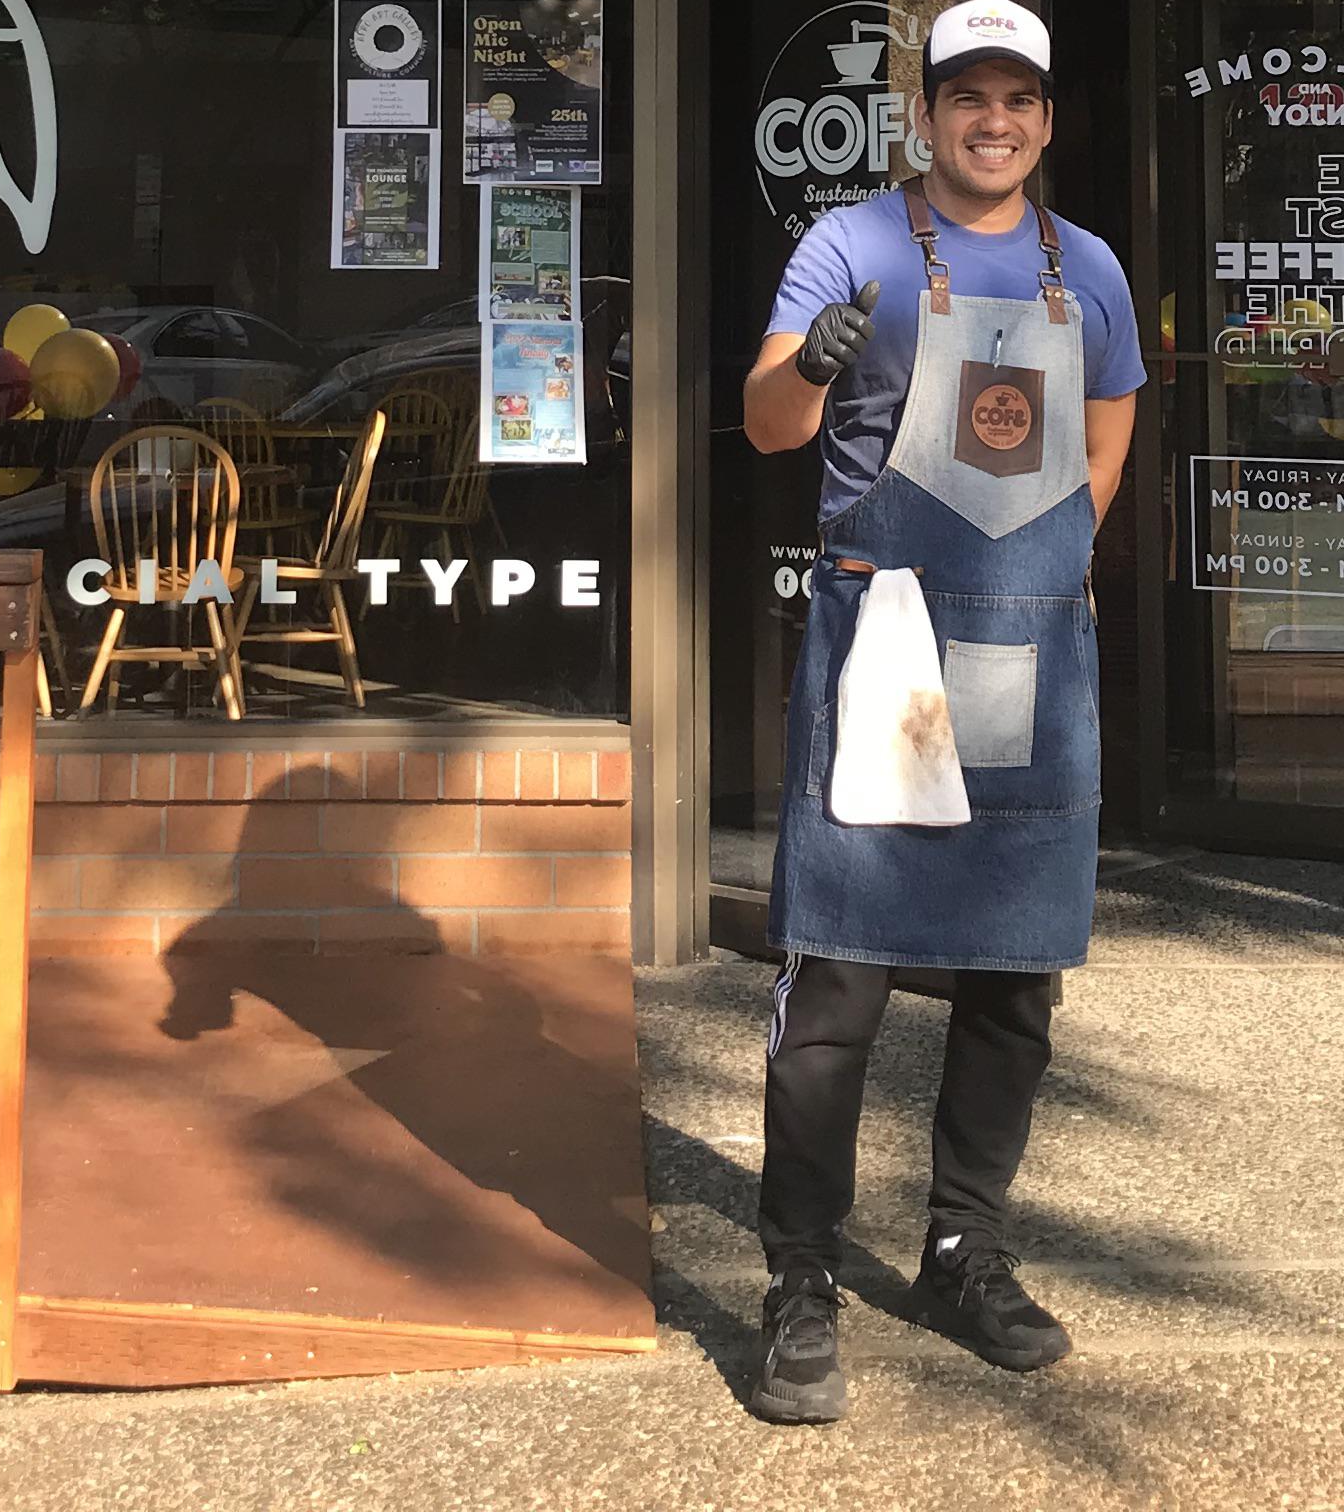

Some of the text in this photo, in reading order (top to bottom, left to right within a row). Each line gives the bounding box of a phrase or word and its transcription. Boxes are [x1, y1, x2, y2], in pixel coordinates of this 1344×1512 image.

[474, 17, 522, 33] Open
[474, 33, 509, 46] Mic
[474, 49, 526, 66] Night
[551, 108, 588, 121] 25th
[366, 175, 407, 183] LOUNGE
[66, 558, 602, 608] CIAL TYPE
